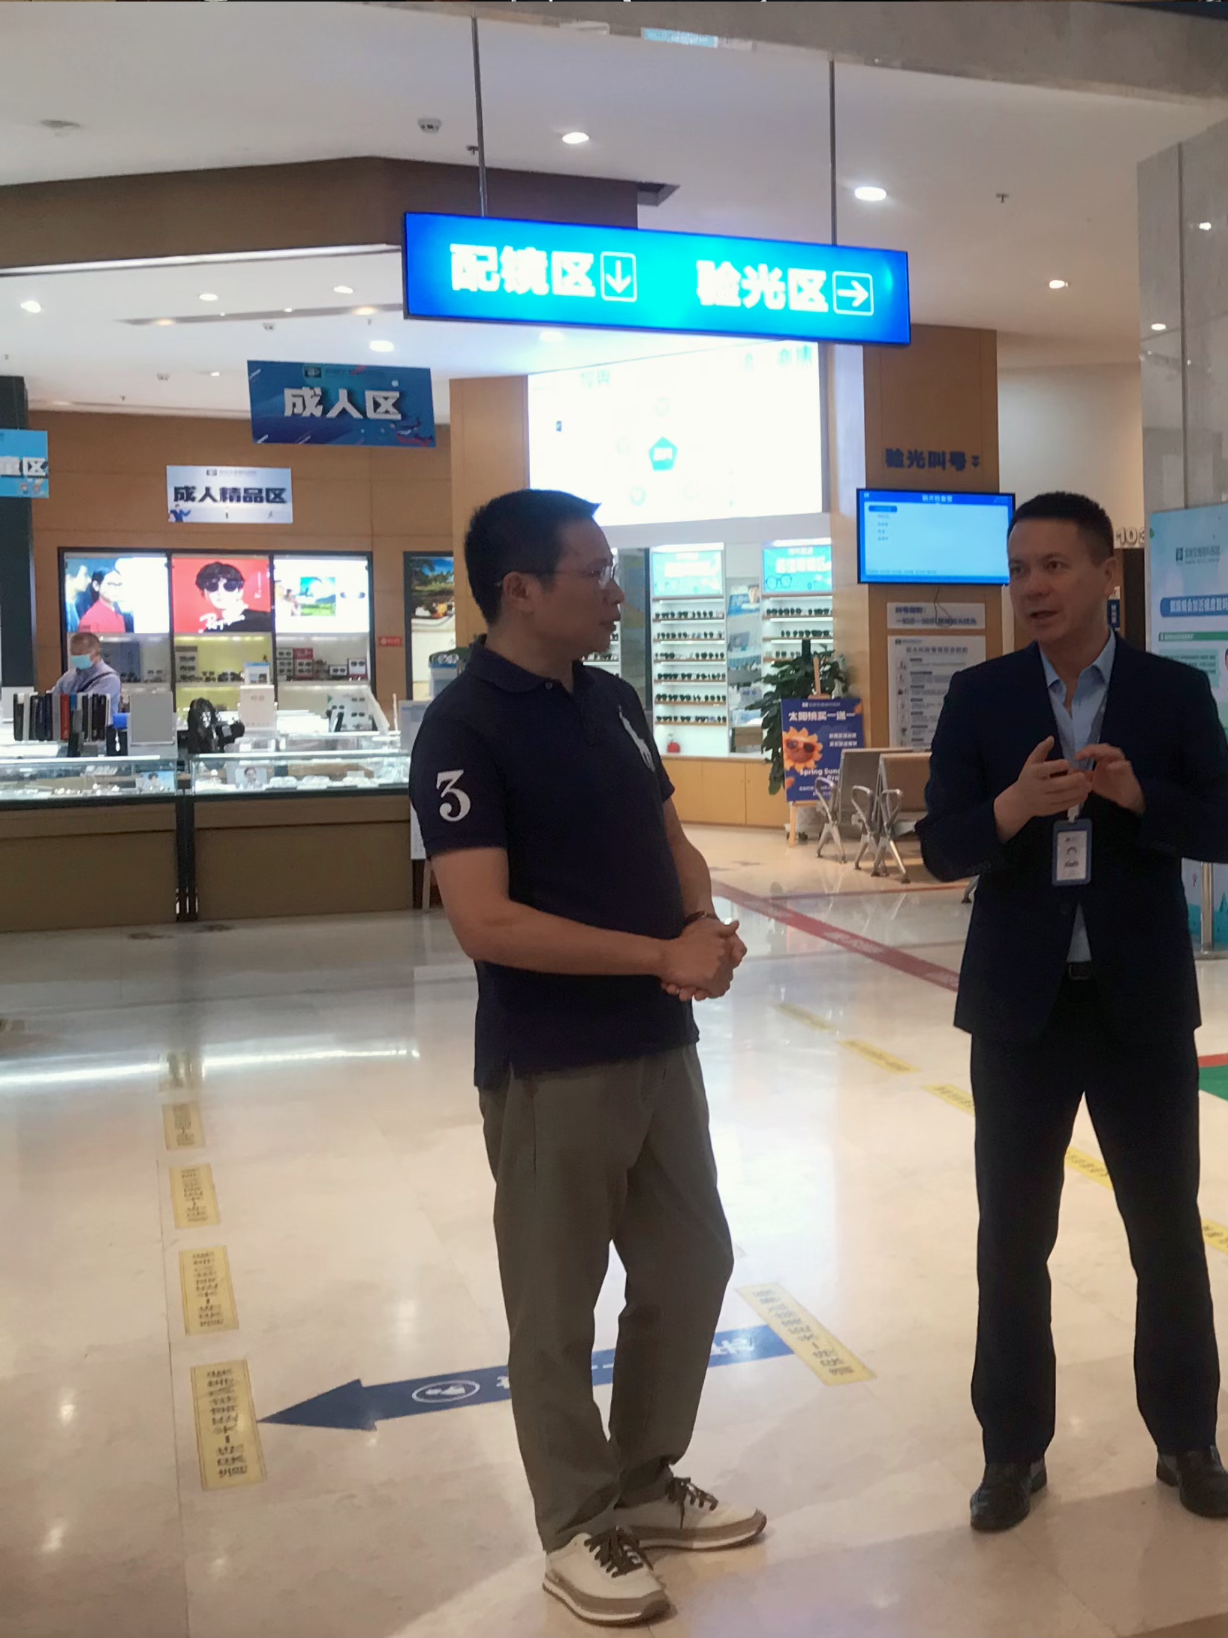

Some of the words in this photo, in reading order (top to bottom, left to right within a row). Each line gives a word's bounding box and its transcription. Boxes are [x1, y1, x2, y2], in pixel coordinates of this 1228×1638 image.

[450, 243, 596, 297] 配镜区
[696, 260, 828, 312] 验光区
[284, 387, 402, 420] 成人区
[885, 448, 967, 471] 验光叫号
[173, 486, 287, 504] 成人精品区
[436, 769, 471, 822] 3
